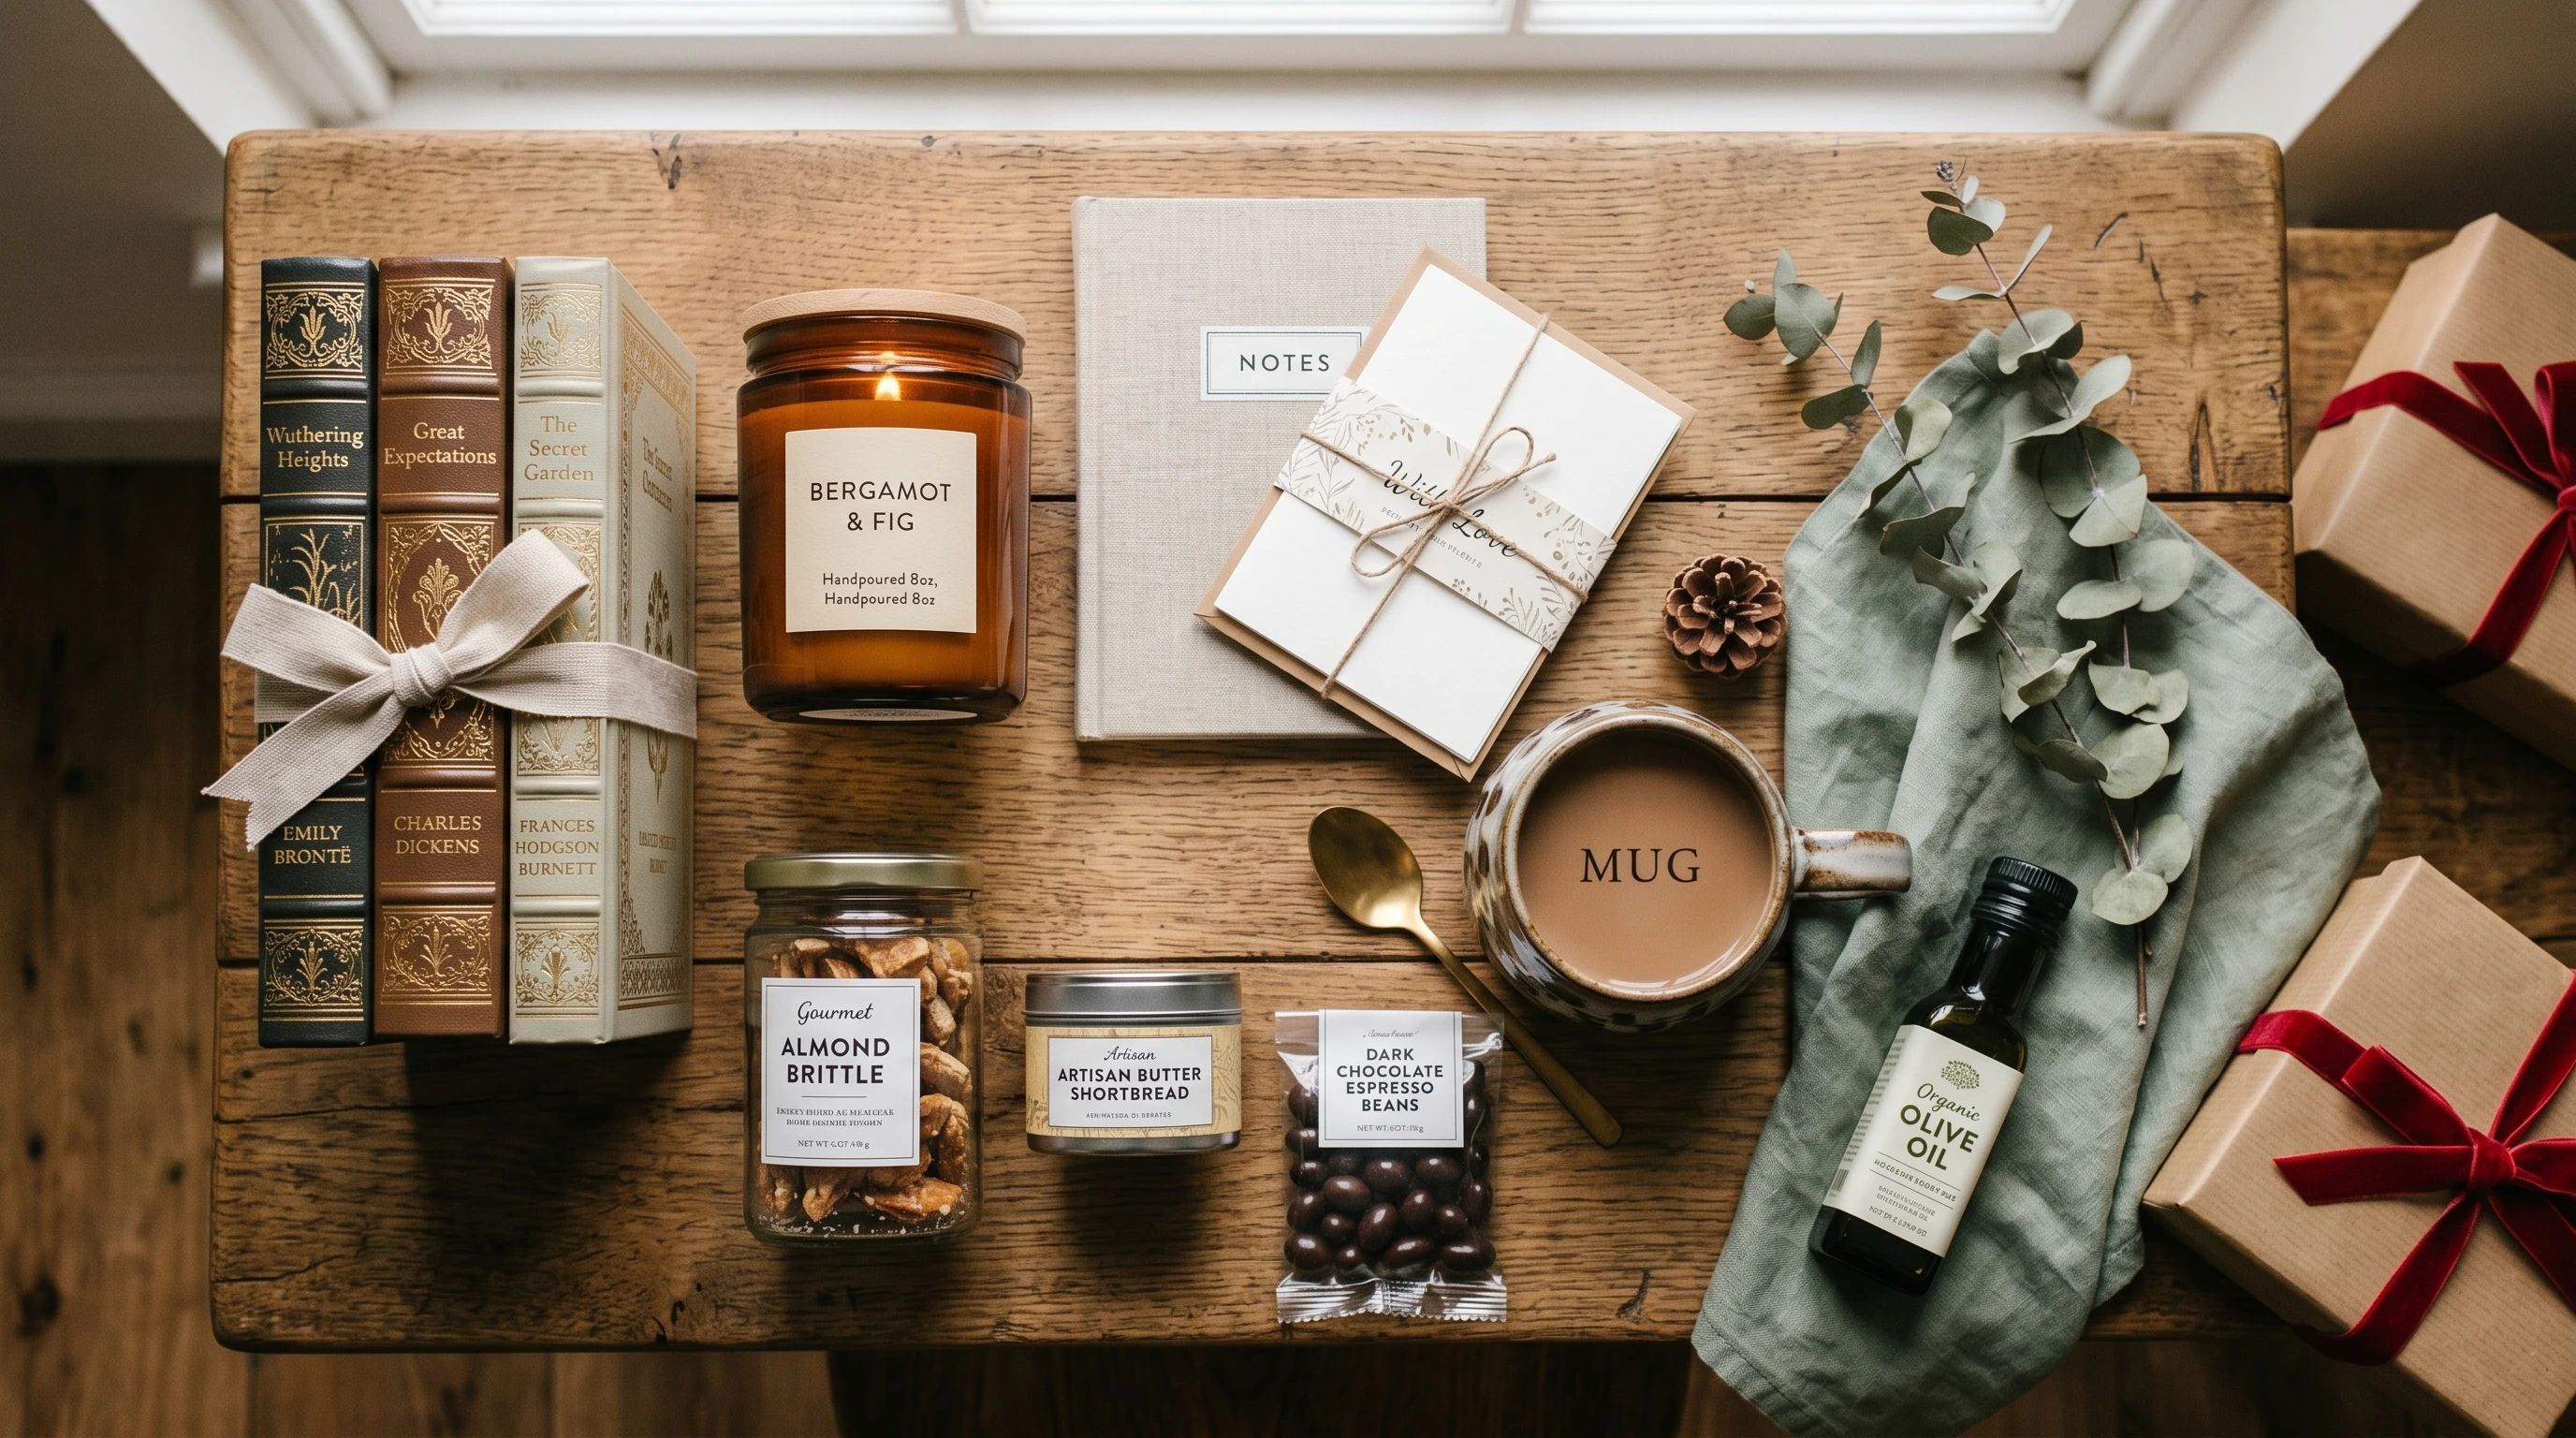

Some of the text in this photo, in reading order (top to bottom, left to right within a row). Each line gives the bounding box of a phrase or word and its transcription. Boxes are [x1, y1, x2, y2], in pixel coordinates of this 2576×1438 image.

[1240, 354, 1330, 372] NOTES
[413, 422, 465, 440] Great
[540, 415, 578, 433] The
[267, 426, 364, 449] Wuthering
[529, 439, 588, 457] Secret
[278, 450, 349, 472] Heights
[384, 448, 497, 470] Expectations
[523, 462, 594, 481] Garden
[811, 481, 952, 502] BERGAMOT
[847, 512, 914, 532] & FIG
[1452, 508, 1517, 557] Love
[823, 572, 938, 589] Handpoured 8oz,
[825, 592, 935, 609] Handpoured 8oz
[394, 815, 482, 831] CHARLES
[520, 819, 595, 833] FRANCES
[284, 825, 343, 841] EMILY
[274, 844, 352, 864] BRONTË
[396, 839, 480, 855] DICKENS
[515, 841, 599, 855] HODGSON
[518, 862, 597, 876] BURNETT
[1579, 847, 1701, 883] MUG
[798, 1001, 874, 1025] Gourmet
[781, 1036, 890, 1057] ALMOND
[1104, 1046, 1157, 1061] Artisan
[1367, 1049, 1414, 1061] DARK
[787, 1064, 884, 1084] BRITTLE
[1058, 1067, 1202, 1082] ARTISAN BUTTER
[1337, 1065, 1443, 1078] CHOCOLATE
[1071, 1086, 1190, 1100] SHORTBREAD
[1346, 1081, 1434, 1094] ESPRESSO
[1362, 1099, 1419, 1111] BEANS
[1916, 1082, 1981, 1122] Organic
[1900, 1105, 1979, 1152] OLIVE
[1907, 1137, 1947, 1170] OIL
